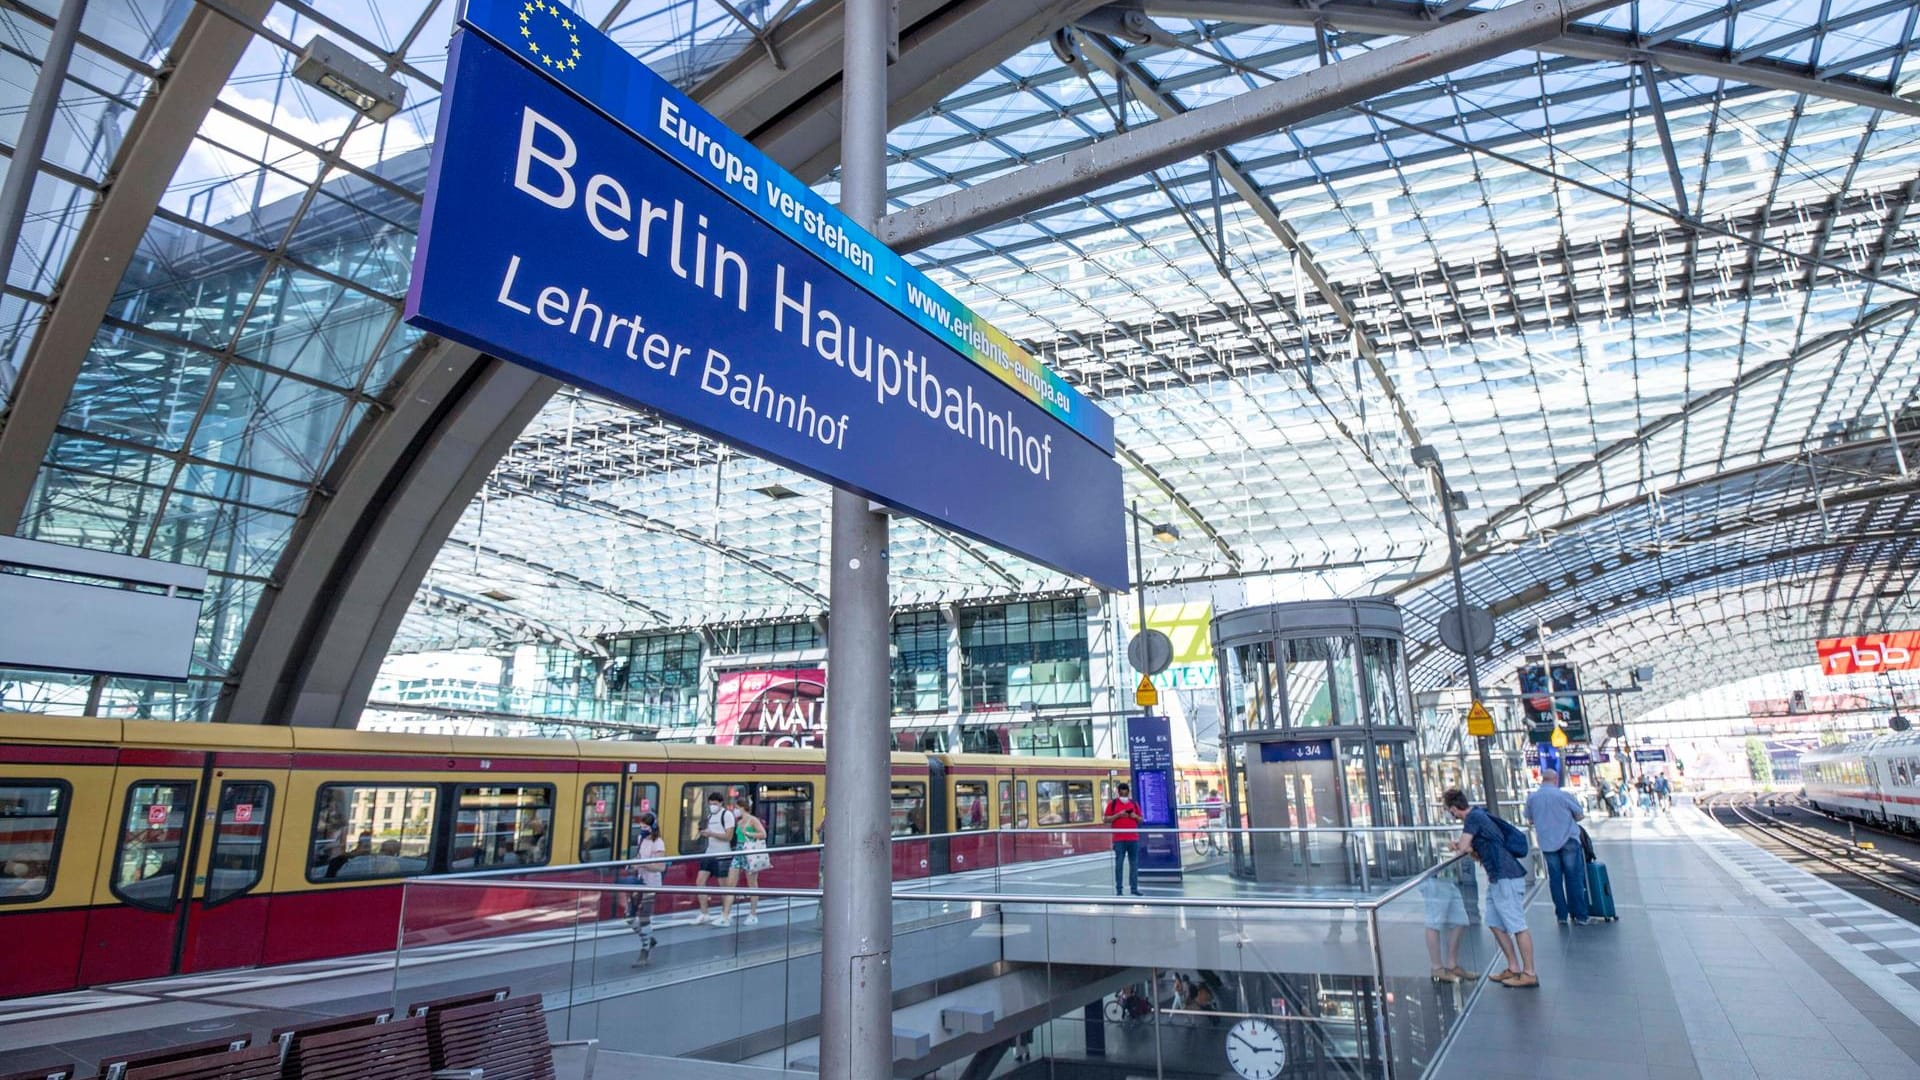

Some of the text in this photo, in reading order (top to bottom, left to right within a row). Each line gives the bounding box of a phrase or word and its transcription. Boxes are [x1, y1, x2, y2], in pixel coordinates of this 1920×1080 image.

[497, 255, 849, 451] Lehrter Bahnhof
[514, 105, 1052, 481] Berlin Hauptbahnhof
[659, 97, 759, 195] Europa
[766, 180, 874, 275] verstehen
[906, 282, 1070, 413] www.erlebnis-europa.eu
[1305, 745, 1321, 756] 3/4
[1829, 642, 1910, 669] rbb
